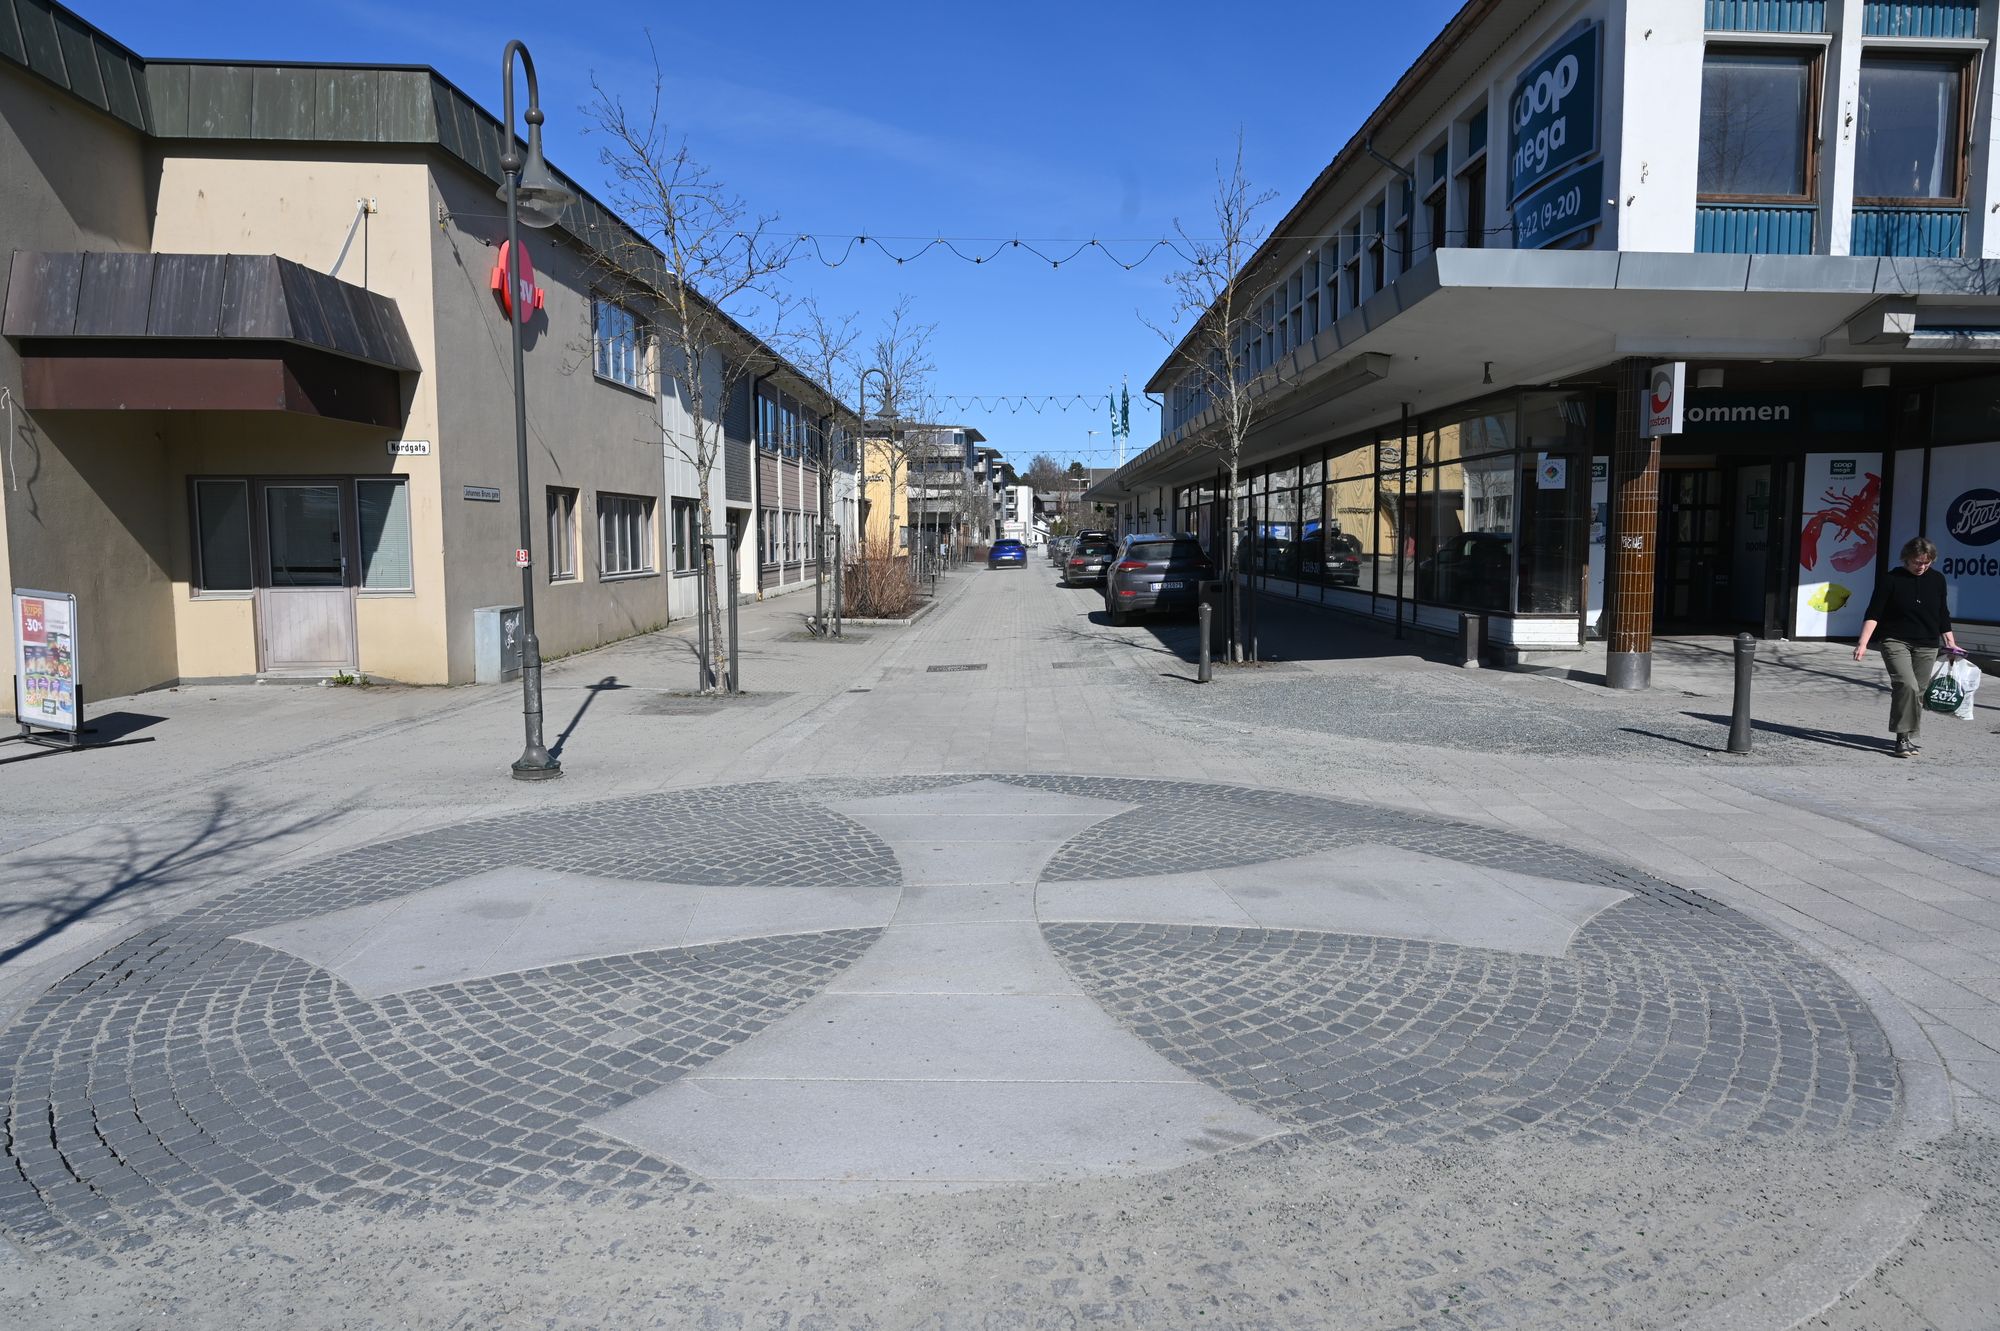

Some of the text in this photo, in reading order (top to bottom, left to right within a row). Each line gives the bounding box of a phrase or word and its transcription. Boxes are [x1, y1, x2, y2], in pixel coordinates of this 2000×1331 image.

[1513, 54, 1579, 135] coop
[1512, 116, 1566, 182] mega
[1518, 186, 1581, 243] 8-22 (9-20)
[391, 443, 426, 453] Nordgata
[1942, 554, 2000, 579] apote
[1930, 689, 1958, 703] 20%
